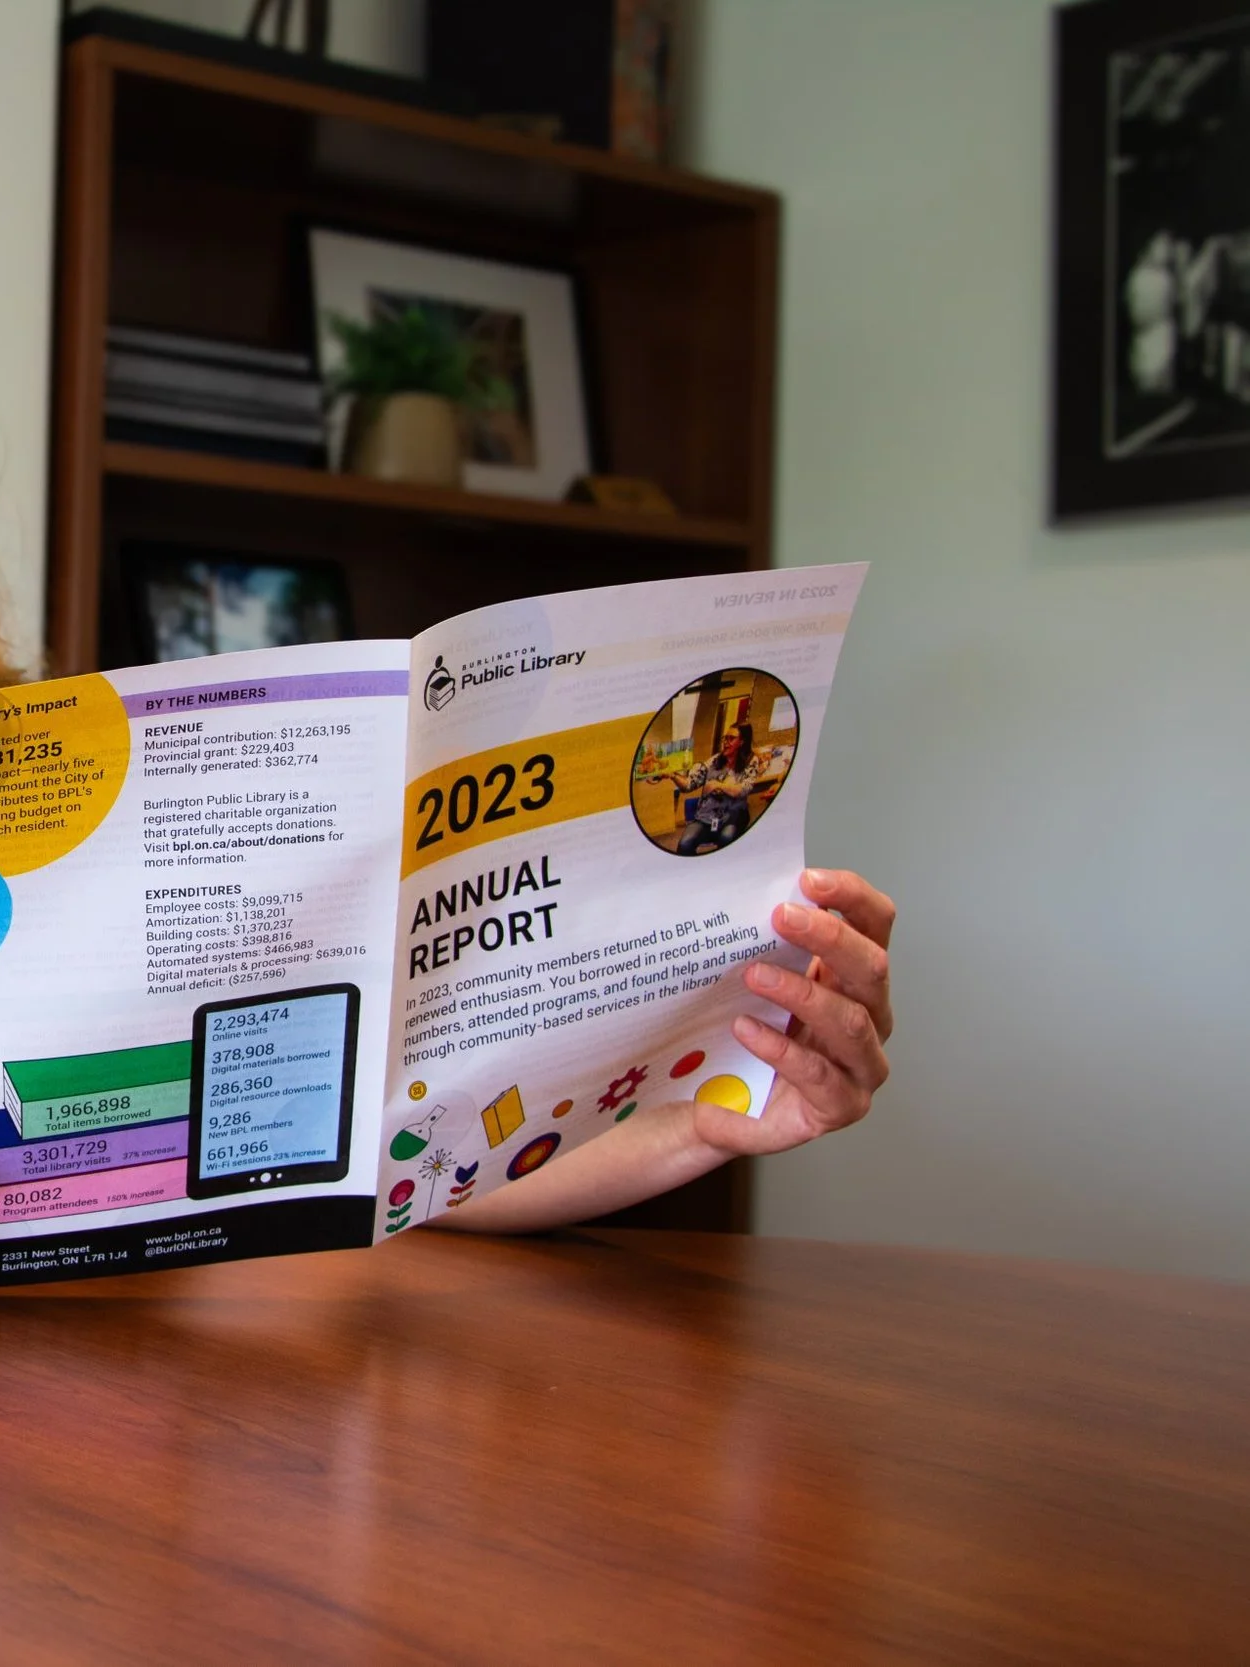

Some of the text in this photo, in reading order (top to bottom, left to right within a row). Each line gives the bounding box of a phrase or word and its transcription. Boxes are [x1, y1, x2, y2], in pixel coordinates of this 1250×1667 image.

[461, 650, 587, 690] Public Library
[462, 646, 536, 672] BURLINGTON
[26, 695, 78, 714] Impact
[145, 698, 164, 711] BY
[166, 694, 194, 708] THE
[198, 686, 267, 704] NUMBERS
[23, 730, 51, 742] over
[144, 721, 203, 738] REVENUE
[144, 724, 351, 750] Municipal contribution: $12,263,195
[72, 757, 95, 768] five
[143, 741, 294, 764] Provincial grant: $229,403
[143, 754, 318, 777] Internally generated: $362,774
[41, 775, 62, 787] the
[64, 772, 89, 784] City
[91, 768, 104, 781] of
[42, 791, 55, 801] to
[143, 789, 309, 810] Burlington Public Library is a
[415, 752, 556, 852] 2023
[19, 804, 62, 818] budget
[65, 803, 81, 813] on
[143, 802, 337, 826] registered charitable organization
[14, 818, 68, 833] resident.
[143, 817, 336, 840] that gratefully accepts donations.
[143, 830, 344, 854] Visit bpl.on.ca/about/donations for
[144, 852, 247, 868] more information.
[145, 884, 242, 900] EXPENDITURES
[145, 892, 303, 915] Employee costs: $9,099,715
[410, 855, 562, 936] ANNUAL
[145, 906, 285, 928] Amortization: $1,138,201
[146, 918, 294, 942] Building costs: $1,370,237
[408, 902, 559, 980] REPORT
[146, 930, 292, 957] Operating costs: $398,816
[146, 939, 314, 969] Automated systems: $466,983
[146, 945, 366, 983] Digital materials & processing: $639,016
[405, 911, 730, 1012] In 2023, community members returned to BPL with
[146, 967, 286, 995] Annual deficit: ($257,596)
[404, 926, 759, 1030] renewed enthusiasm. You borrowed in record-breaking
[403, 939, 777, 1048] numbers, attended programs, and found help and support
[213, 1007, 289, 1032] 2,293,474
[403, 1040, 455, 1066] through
[458, 1007, 583, 1051] community-based
[586, 995, 640, 1018] services
[643, 990, 655, 1003] in
[658, 985, 679, 999] the
[211, 1042, 275, 1064] 378,908
[211, 1049, 331, 1075] Digital materials borrowed
[210, 1075, 273, 1097] 286,360
[45, 1095, 131, 1121] 1,966,898
[45, 1108, 151, 1132] Total items borrowed
[208, 1110, 251, 1130] 9,286
[22, 1139, 107, 1165] 3,301,729
[207, 1139, 269, 1161] 661,966
[2, 1198, 98, 1216] Program attendees
[3, 1186, 62, 1206] 80,082
[144, 1236, 228, 1257] @BurlONLibrary
[145, 1226, 222, 1245] www.bpl.on.ca
[1, 1250, 128, 1272] Burlington, ON L7R 1J4
[2, 1245, 90, 1261] 2331 New Street
